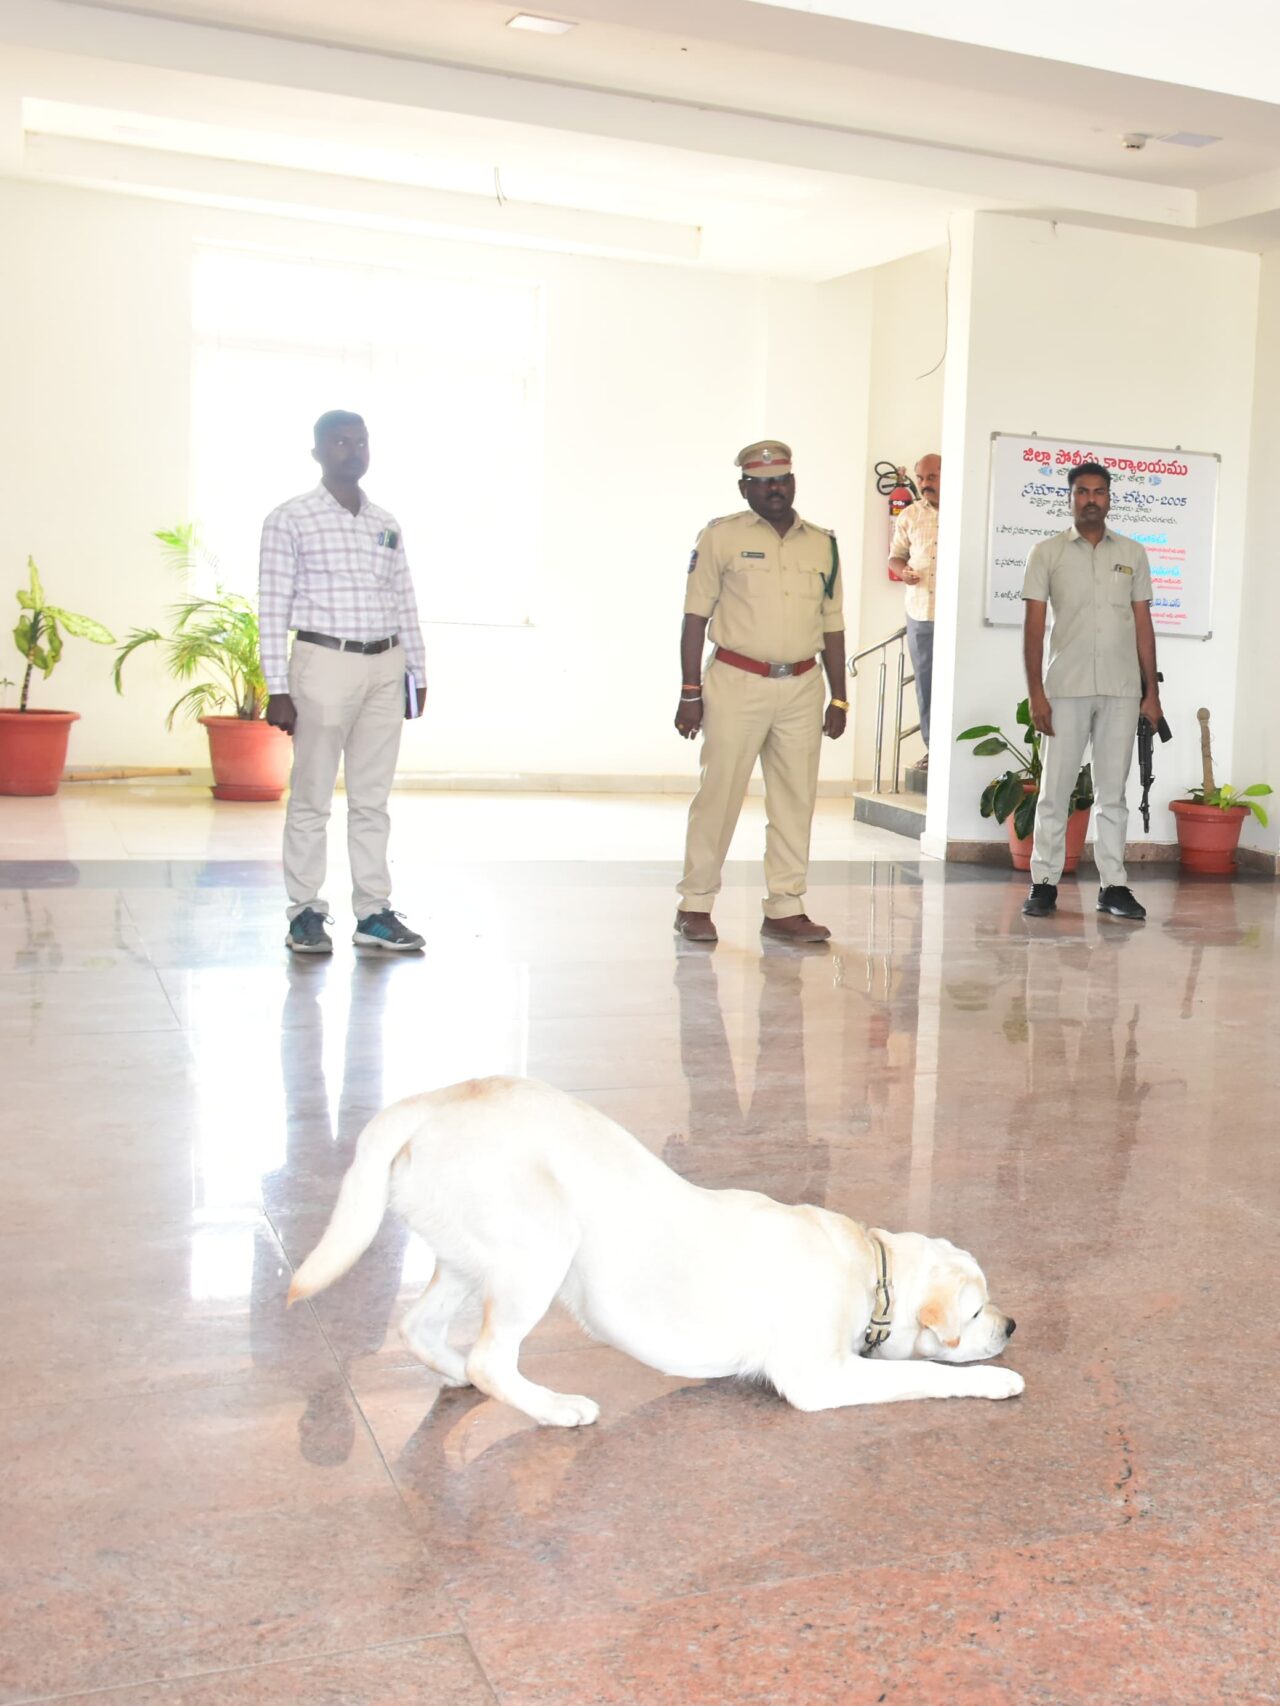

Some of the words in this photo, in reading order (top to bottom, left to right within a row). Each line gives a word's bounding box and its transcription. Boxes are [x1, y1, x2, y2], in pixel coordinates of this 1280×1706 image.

[1022, 447, 1052, 466] జిల్లా
[1055, 449, 1099, 467] పోలీసు
[1103, 457, 1188, 477] కార్యాలయము
[1021, 482, 1072, 498] సమాచా
